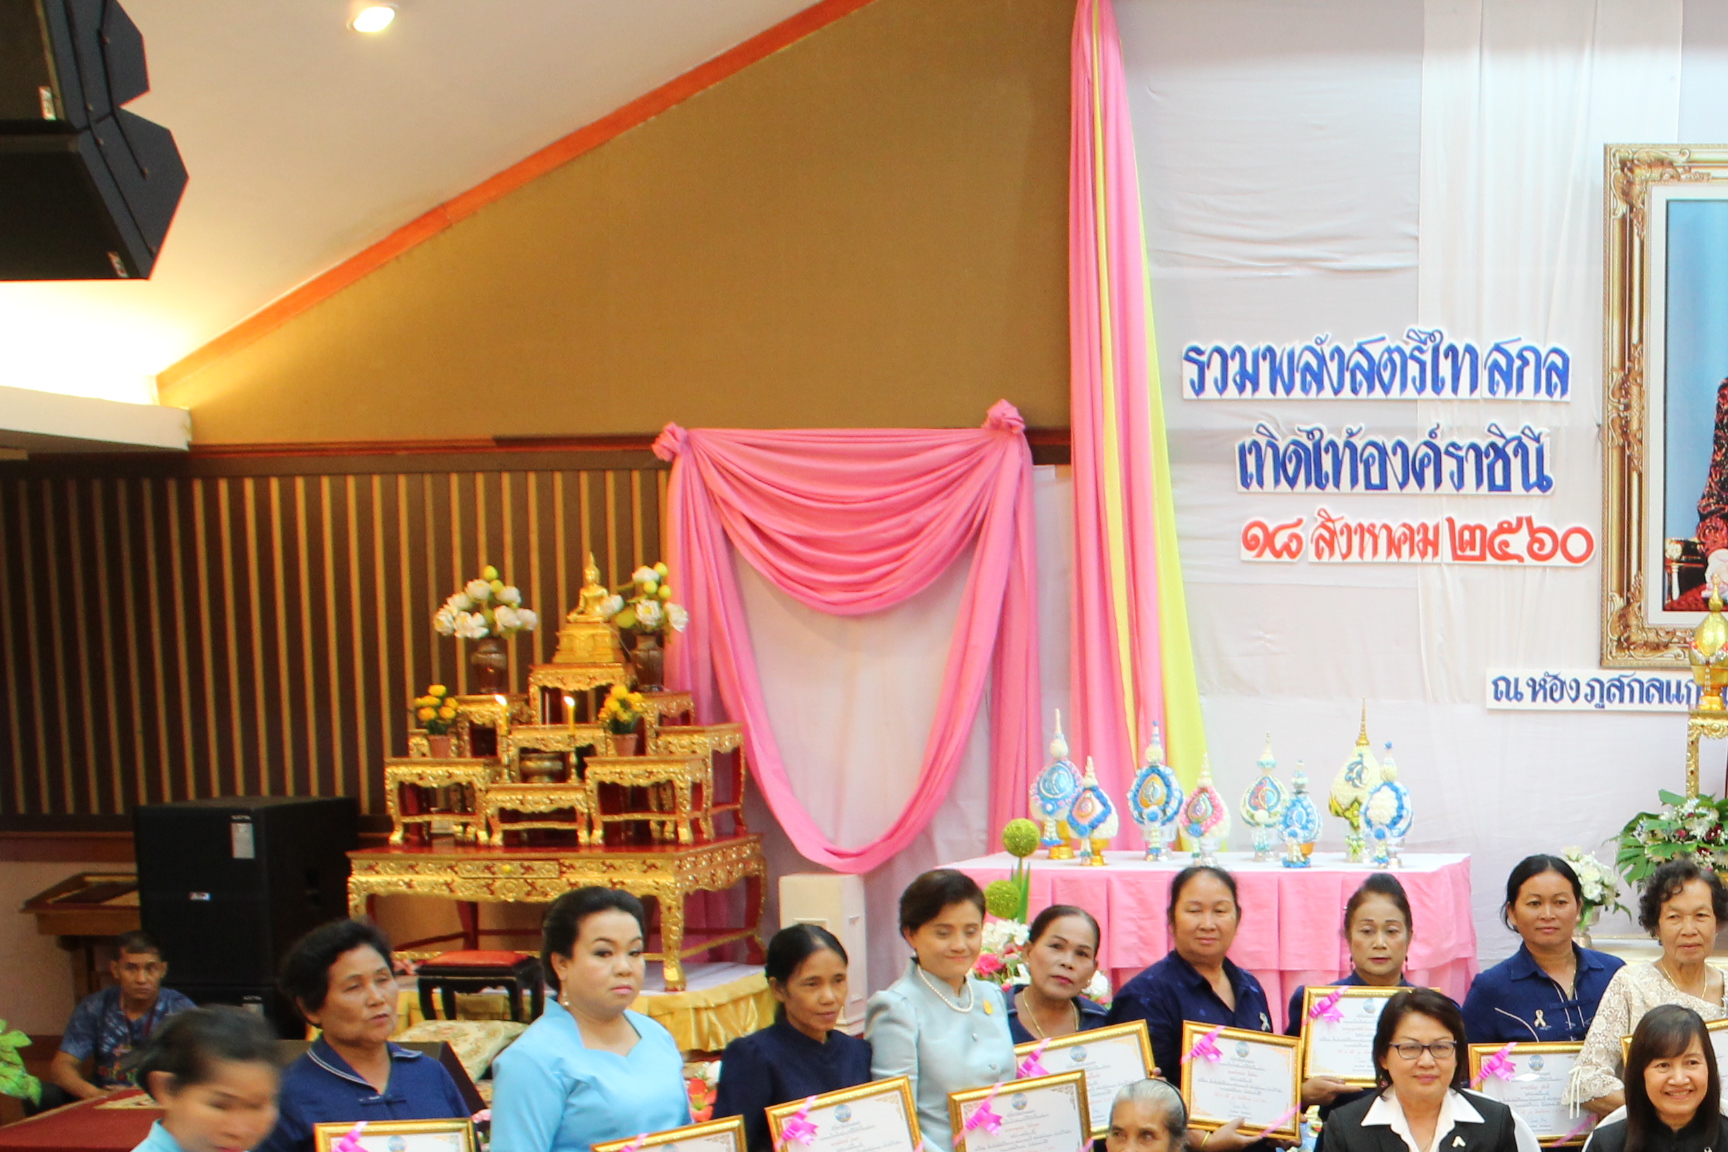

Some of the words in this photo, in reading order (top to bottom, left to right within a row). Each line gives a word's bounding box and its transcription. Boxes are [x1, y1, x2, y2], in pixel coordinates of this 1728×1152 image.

[1311, 507, 1441, 561] สิงหาคม
[1445, 516, 1596, 565] ๒๕๖๐
